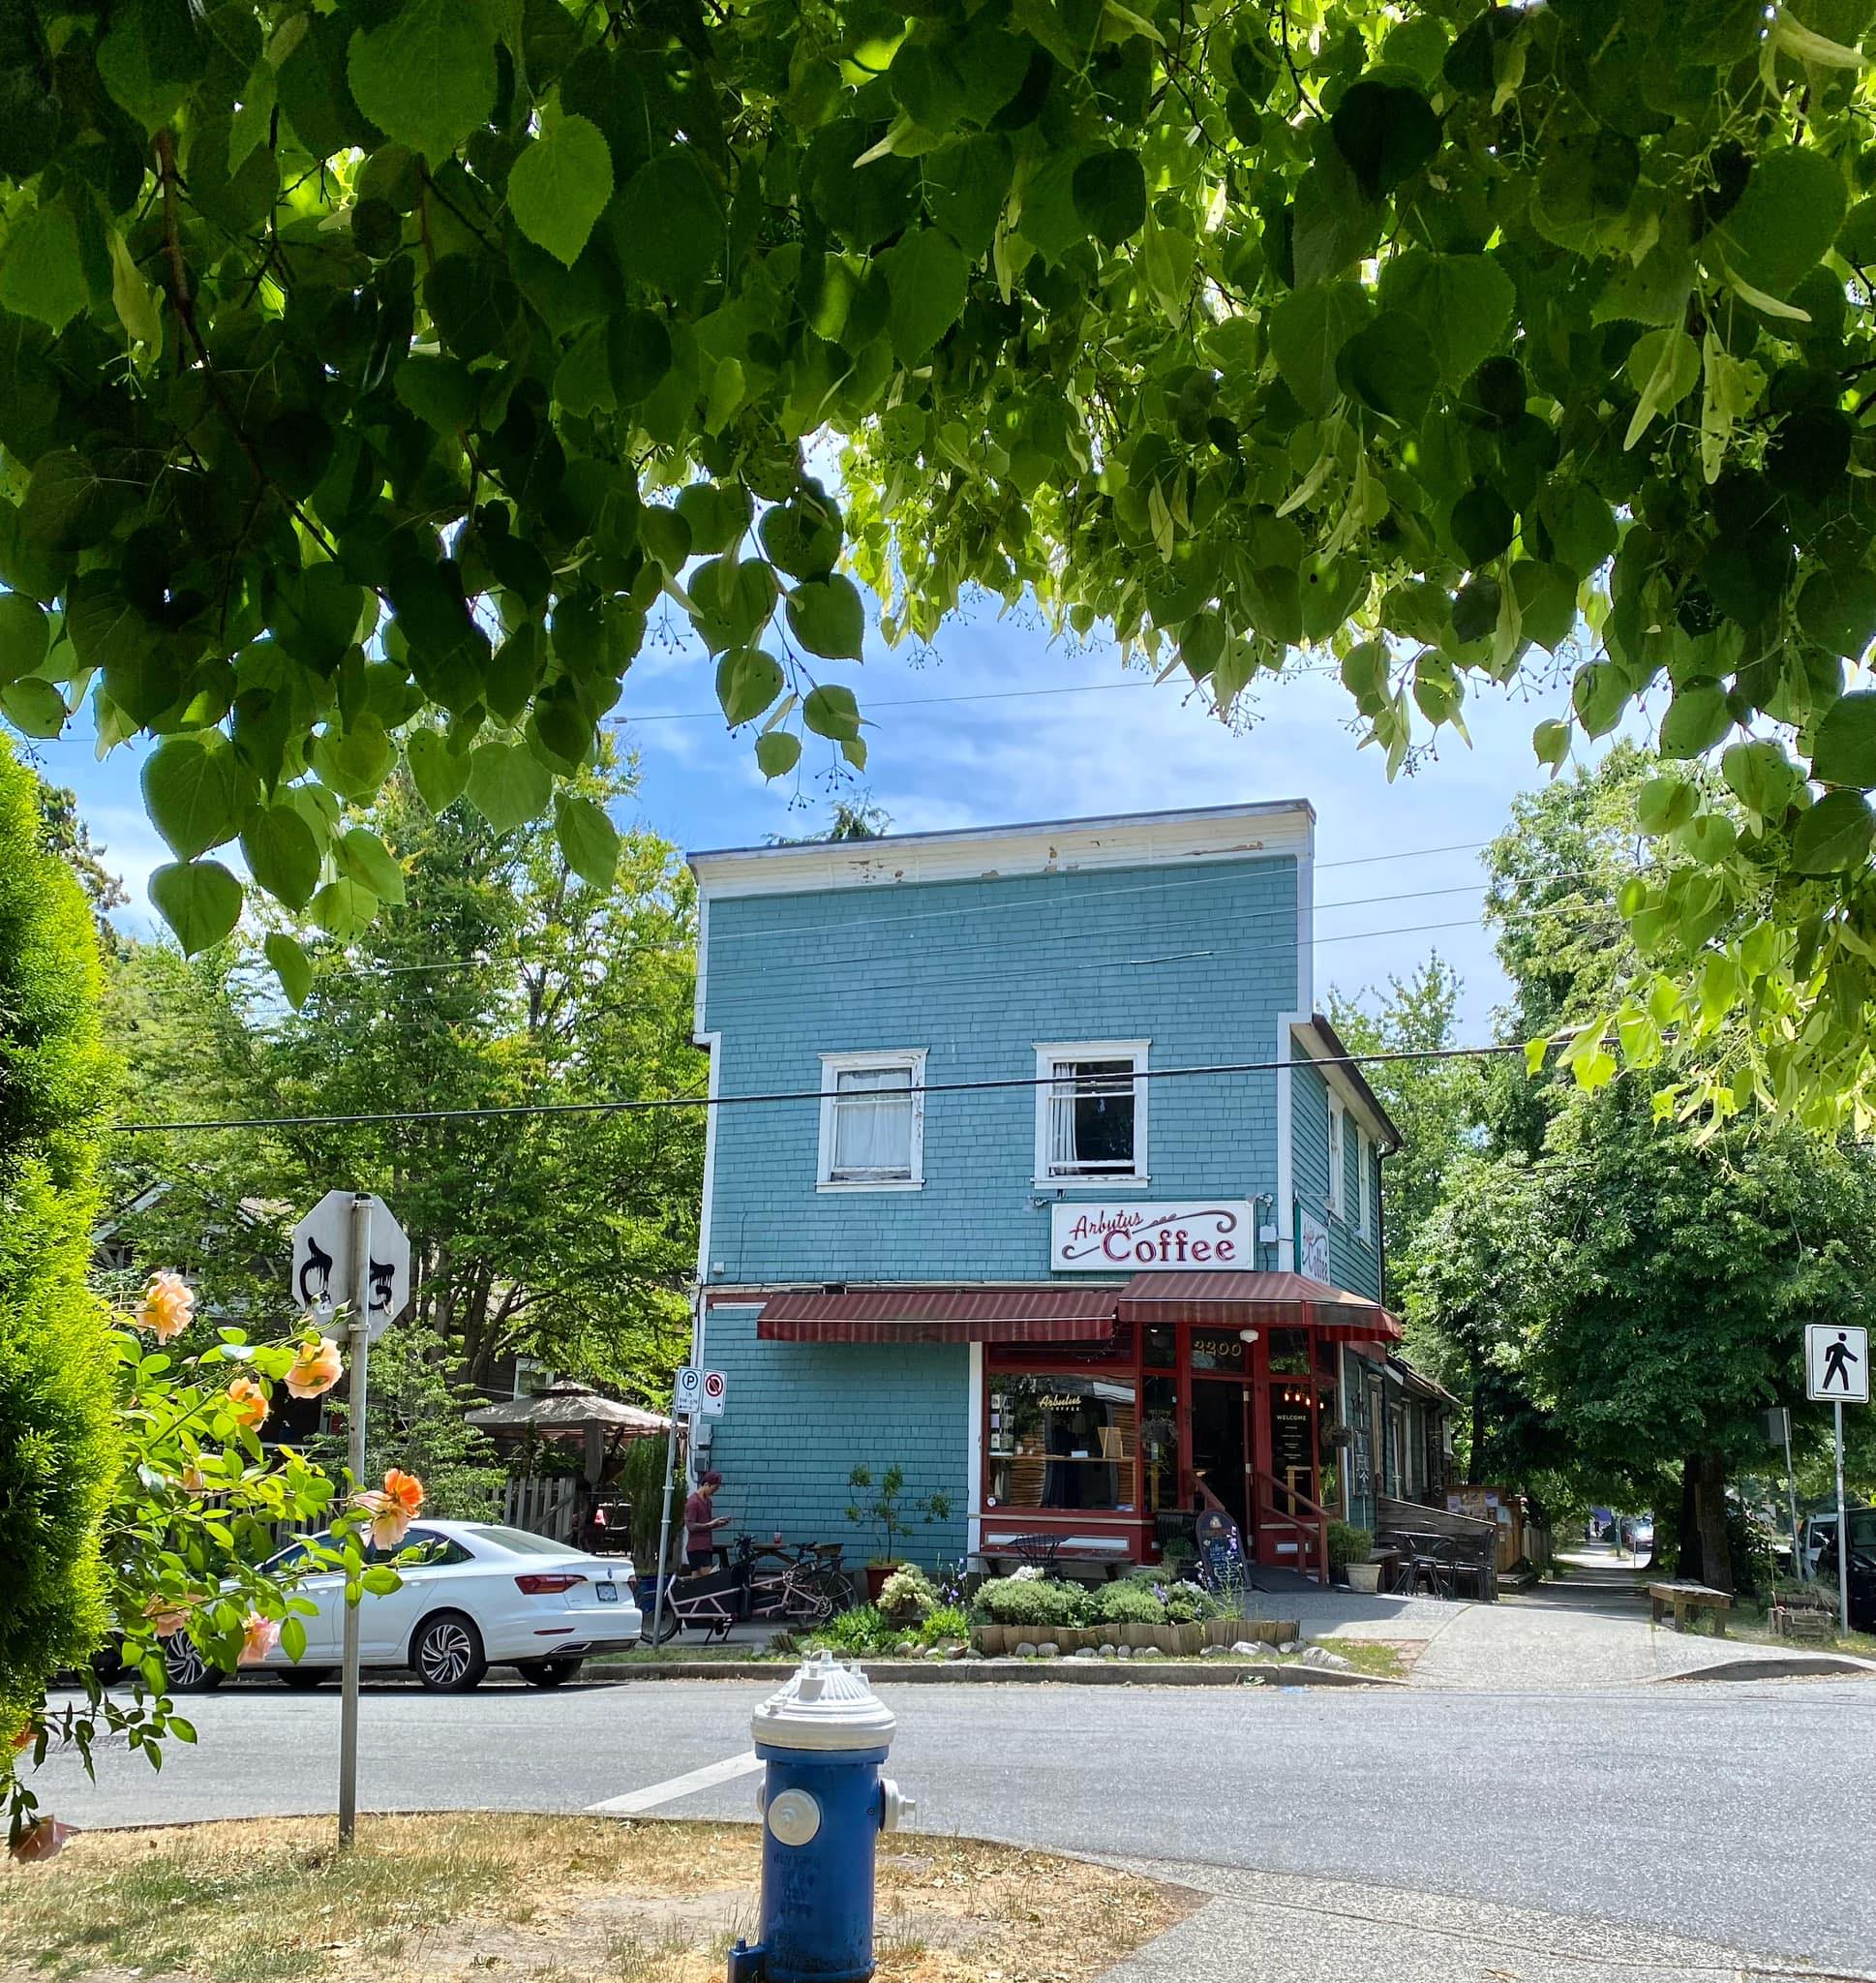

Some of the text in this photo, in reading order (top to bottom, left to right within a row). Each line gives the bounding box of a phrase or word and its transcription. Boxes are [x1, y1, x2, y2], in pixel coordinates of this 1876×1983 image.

[1069, 1209, 1144, 1240] Arbutus
[1102, 1228, 1236, 1263] Coffee
[1192, 1339, 1242, 1357] 2200
[1039, 1393, 1082, 1408] Arbutus
